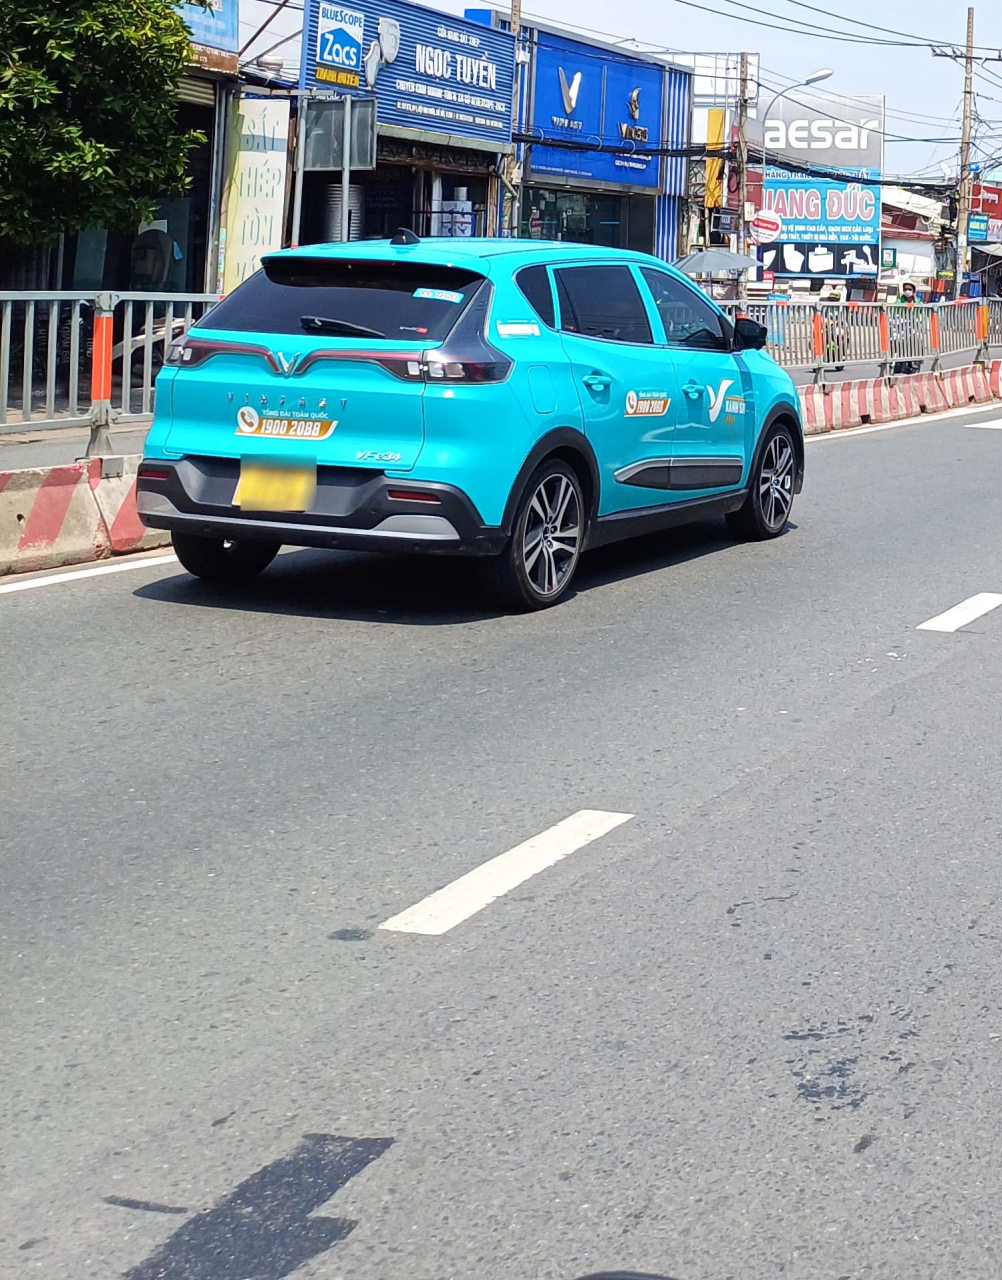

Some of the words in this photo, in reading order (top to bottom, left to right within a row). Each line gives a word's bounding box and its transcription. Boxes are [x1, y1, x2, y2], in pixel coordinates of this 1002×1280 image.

[323, 33, 357, 66] Zacs
[415, 43, 452, 82] NGỌC
[455, 51, 497, 90] TUYỀN
[826, 182, 876, 222] ĐỨC
[435, 291, 459, 301] TAXI
[262, 408, 279, 417] TỔNG
[280, 409, 291, 417] ĐÀI
[292, 410, 309, 418] TOÀN
[310, 411, 329, 419] QUỐC
[260, 419, 288, 435] 1900
[289, 420, 321, 436] 2088
